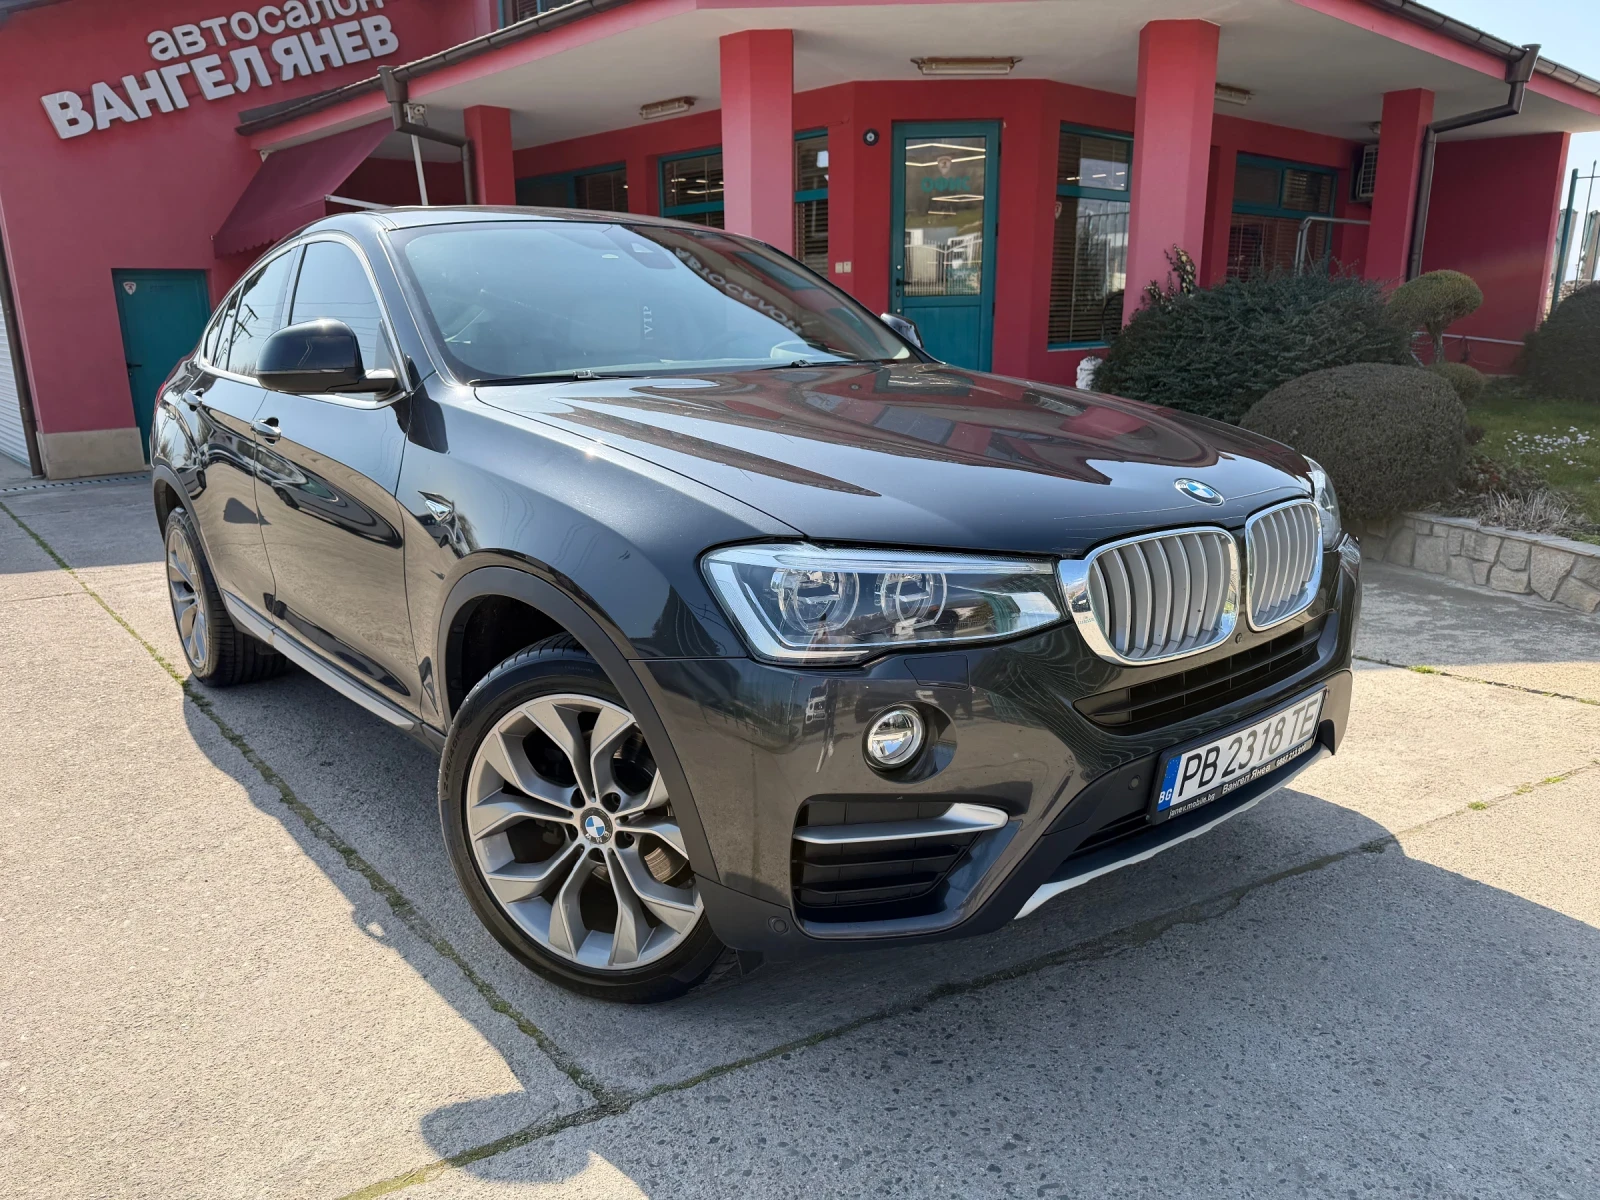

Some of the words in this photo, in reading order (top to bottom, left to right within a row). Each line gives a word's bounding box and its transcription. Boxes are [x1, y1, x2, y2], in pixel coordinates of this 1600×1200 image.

[40, 46, 273, 140] ВАНГЕЛ
[271, 15, 399, 81] ЯНЕВ
[1158, 788, 1172, 804] BG
